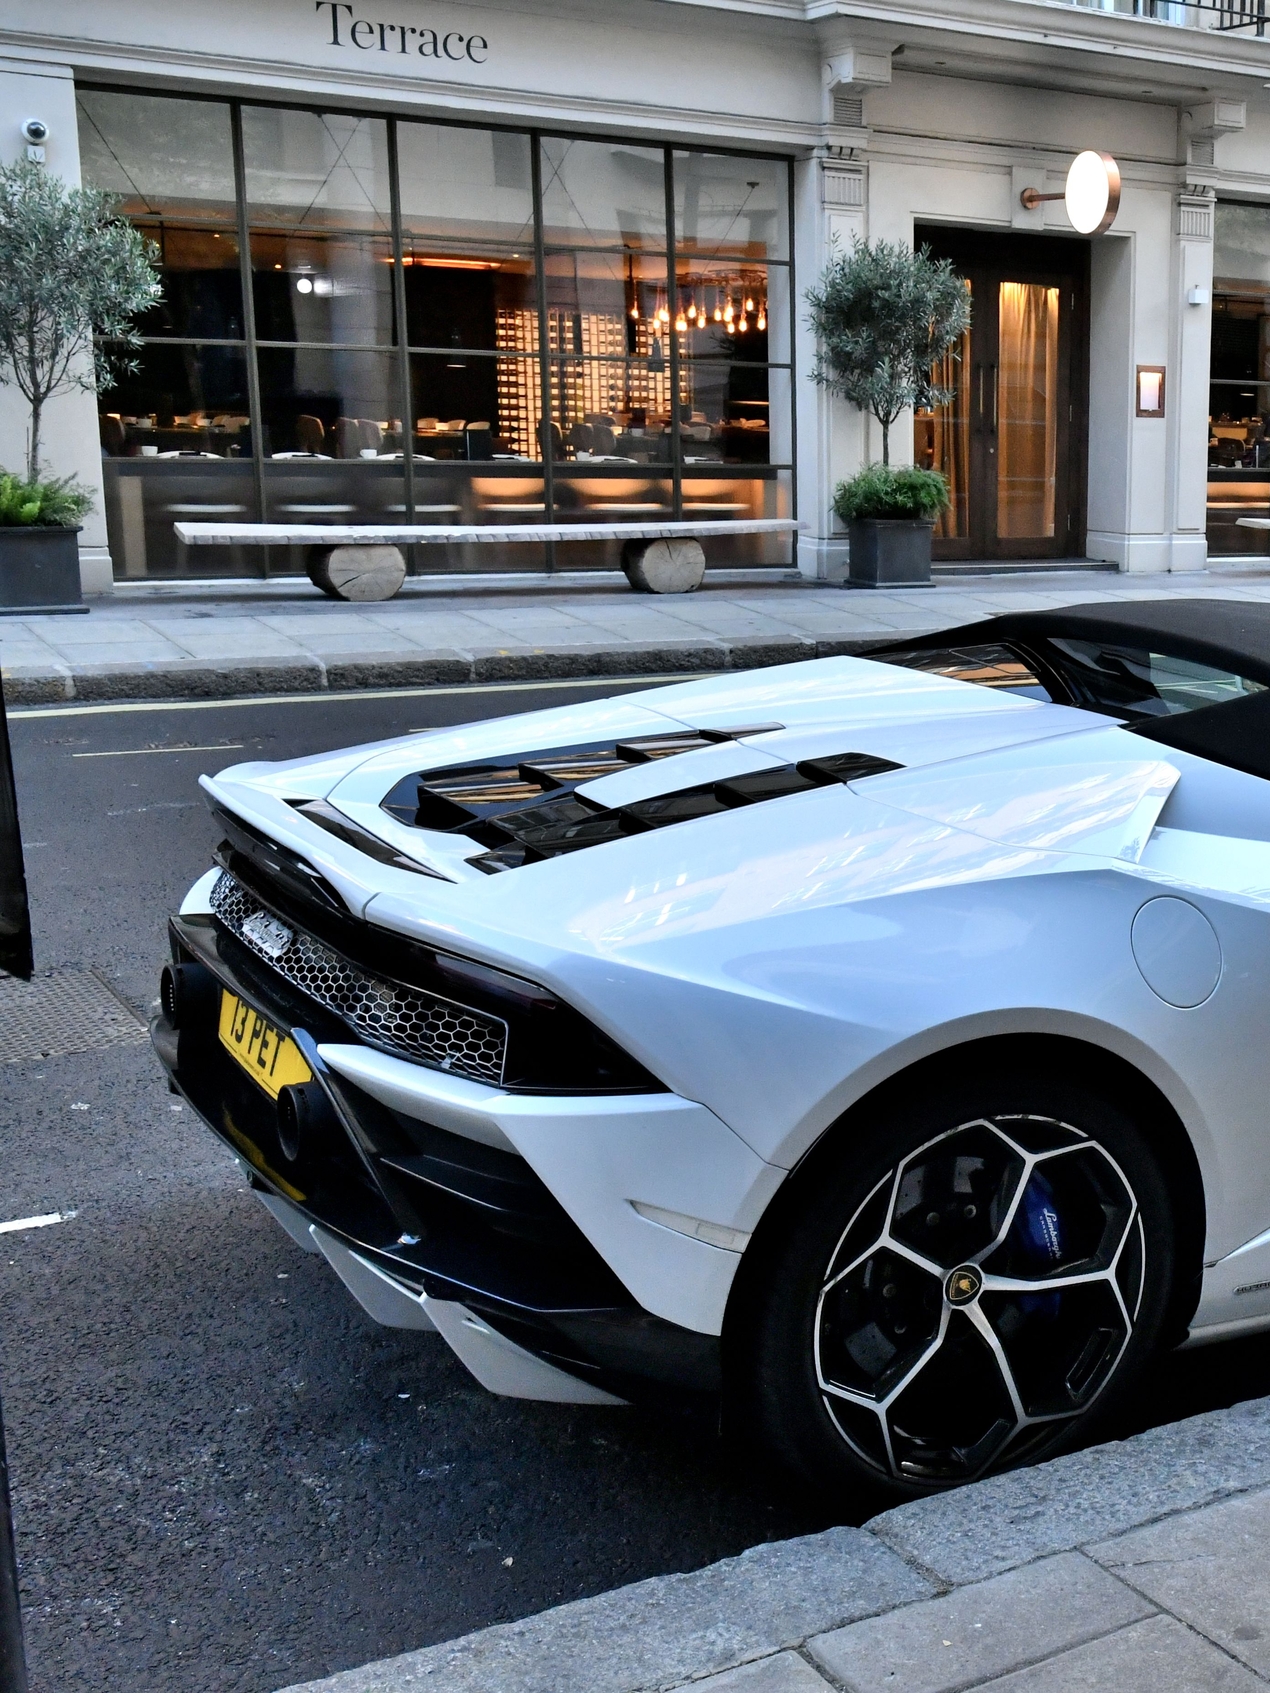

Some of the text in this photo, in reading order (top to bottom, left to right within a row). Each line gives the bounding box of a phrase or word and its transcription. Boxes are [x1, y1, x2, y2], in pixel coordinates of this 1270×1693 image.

[316, 1, 488, 64] Terrace
[231, 998, 250, 1044] 13
[247, 1014, 286, 1077] PET
